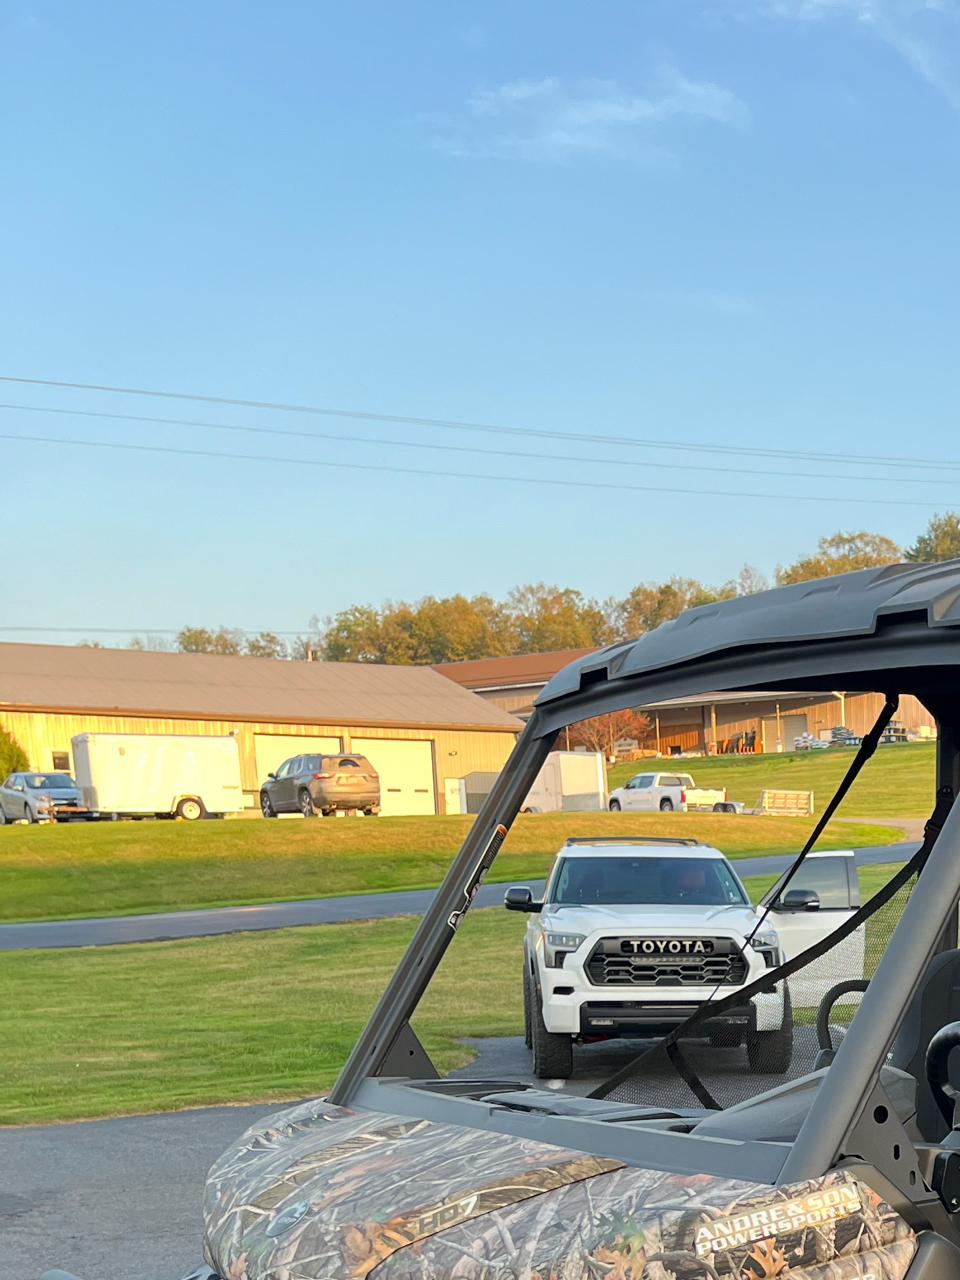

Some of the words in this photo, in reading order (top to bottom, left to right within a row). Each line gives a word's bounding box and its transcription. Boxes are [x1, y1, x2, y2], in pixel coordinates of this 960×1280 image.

[630, 941, 705, 953] TOYOTA
[695, 1200, 862, 1256] POWERSPORTS
[696, 1206, 785, 1243] ANDRE
[807, 1186, 858, 1211] SON
